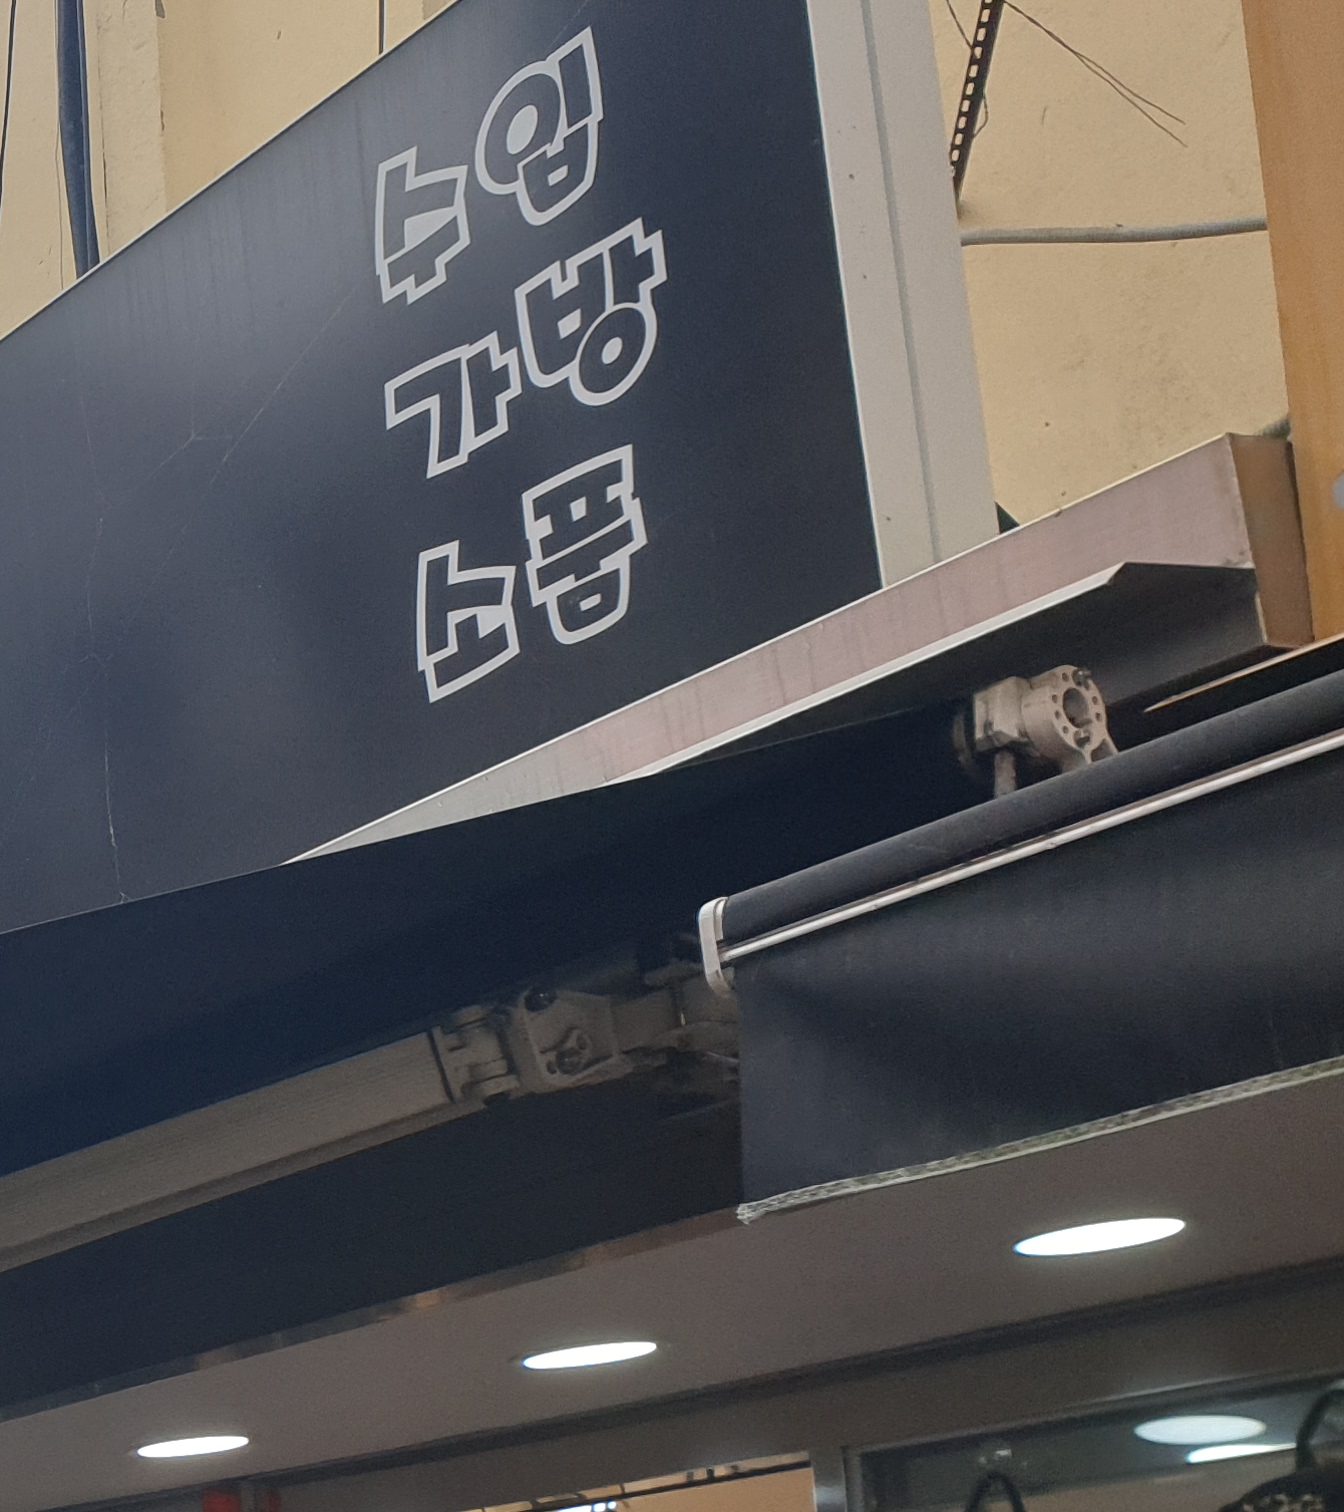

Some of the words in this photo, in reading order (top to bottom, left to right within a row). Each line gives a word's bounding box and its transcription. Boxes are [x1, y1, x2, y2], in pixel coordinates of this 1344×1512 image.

[375, 26, 603, 304] 수입
[384, 217, 668, 478] 가방
[417, 443, 648, 703] 소품
